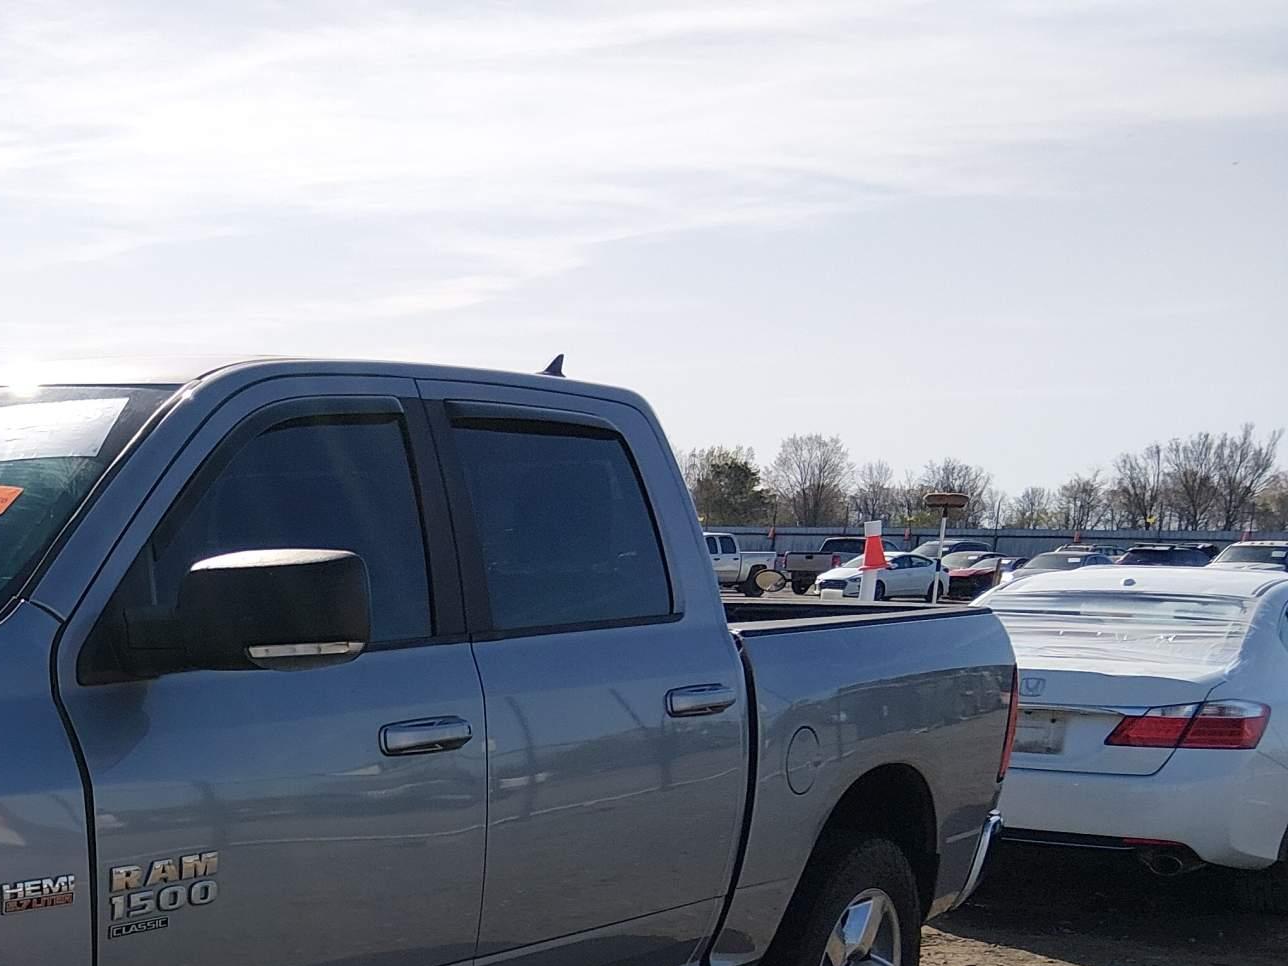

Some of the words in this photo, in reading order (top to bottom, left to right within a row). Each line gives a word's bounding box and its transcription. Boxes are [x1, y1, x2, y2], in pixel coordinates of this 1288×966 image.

[111, 851, 218, 891] RAM
[2, 875, 75, 900] HEMI
[111, 880, 218, 920] 1500
[112, 918, 168, 937] CLASSIC
